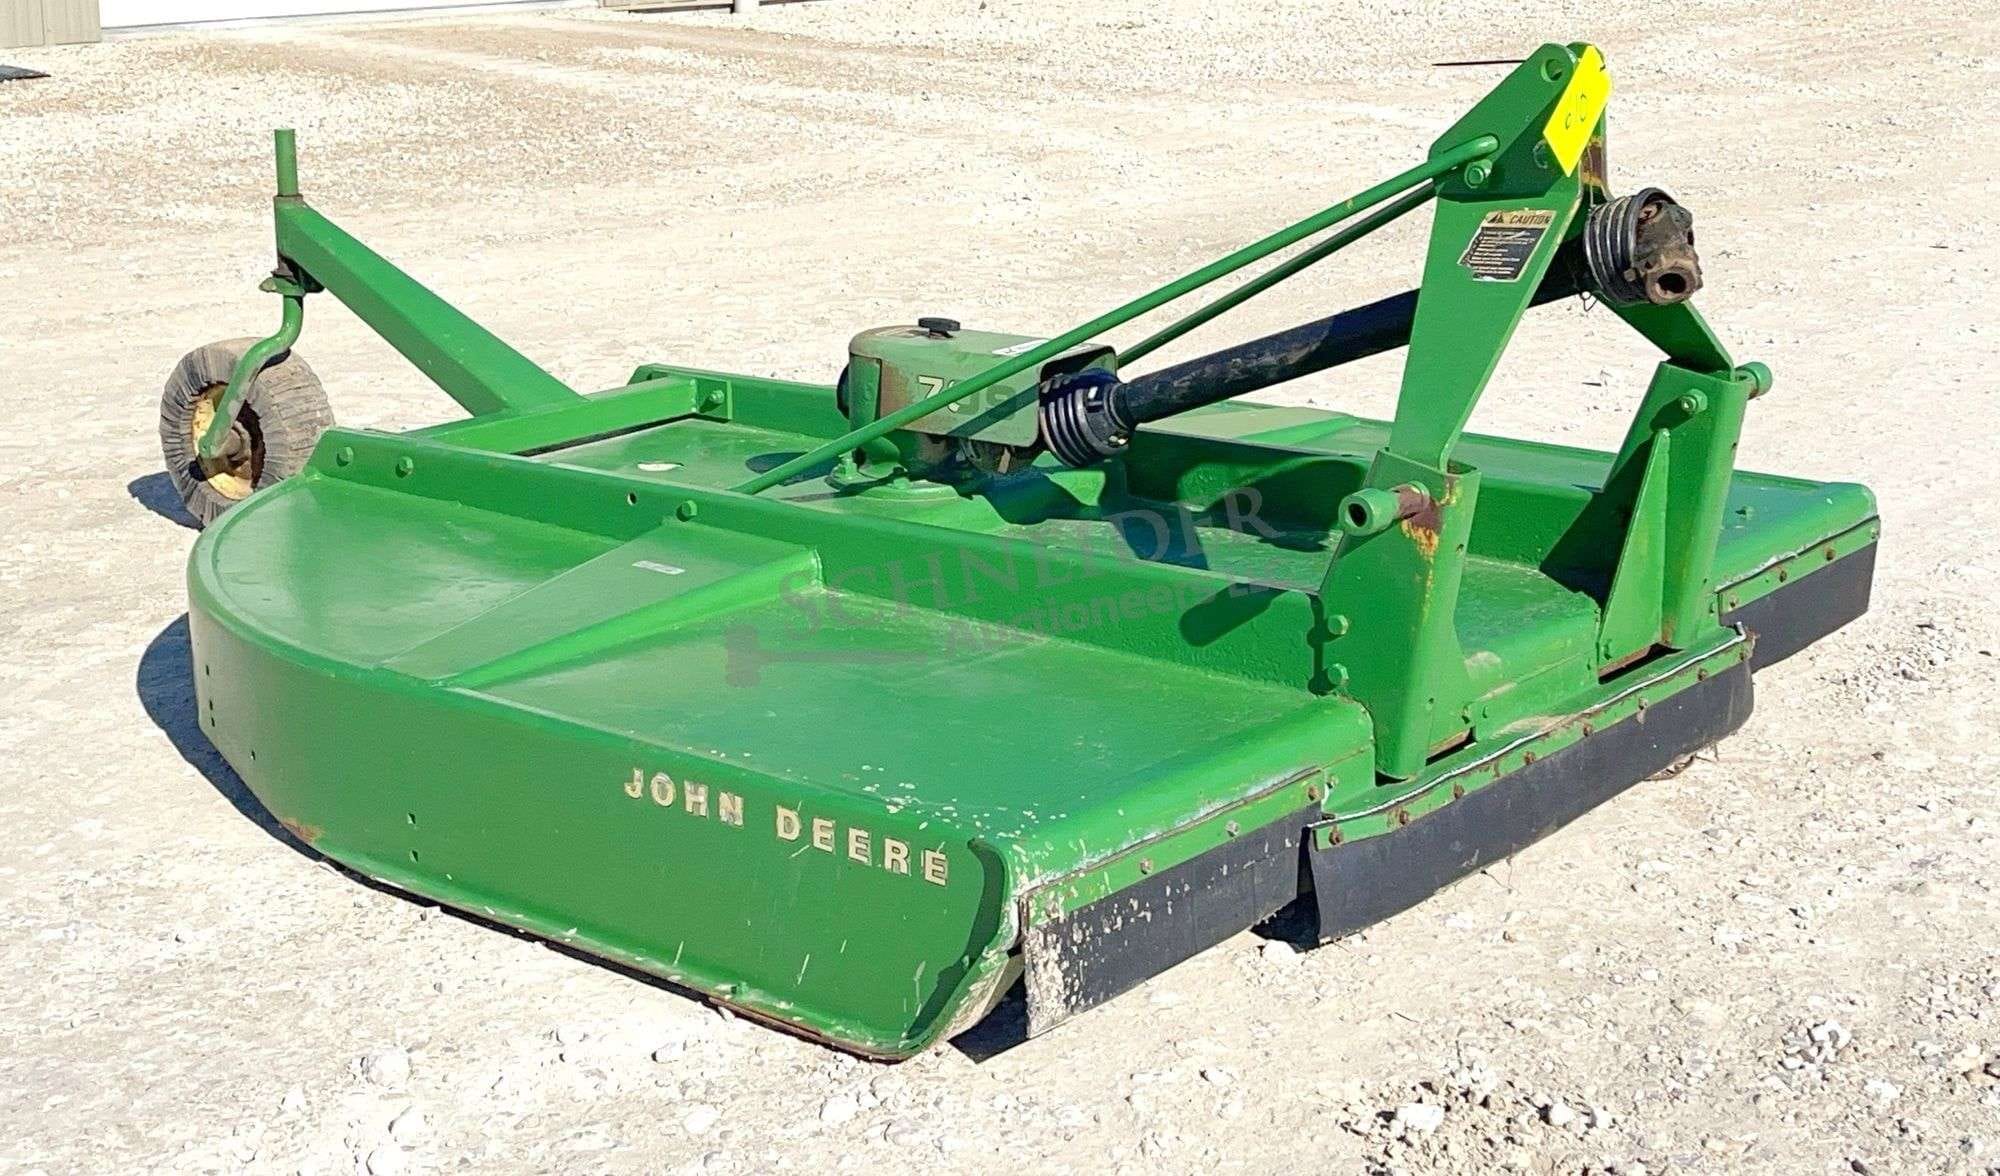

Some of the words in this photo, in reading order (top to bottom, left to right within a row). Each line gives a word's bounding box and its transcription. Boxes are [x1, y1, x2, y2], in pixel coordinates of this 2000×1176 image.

[1509, 214, 1552, 225] CAUTION
[624, 767, 745, 829] JOHN
[776, 804, 949, 887] DEERE
